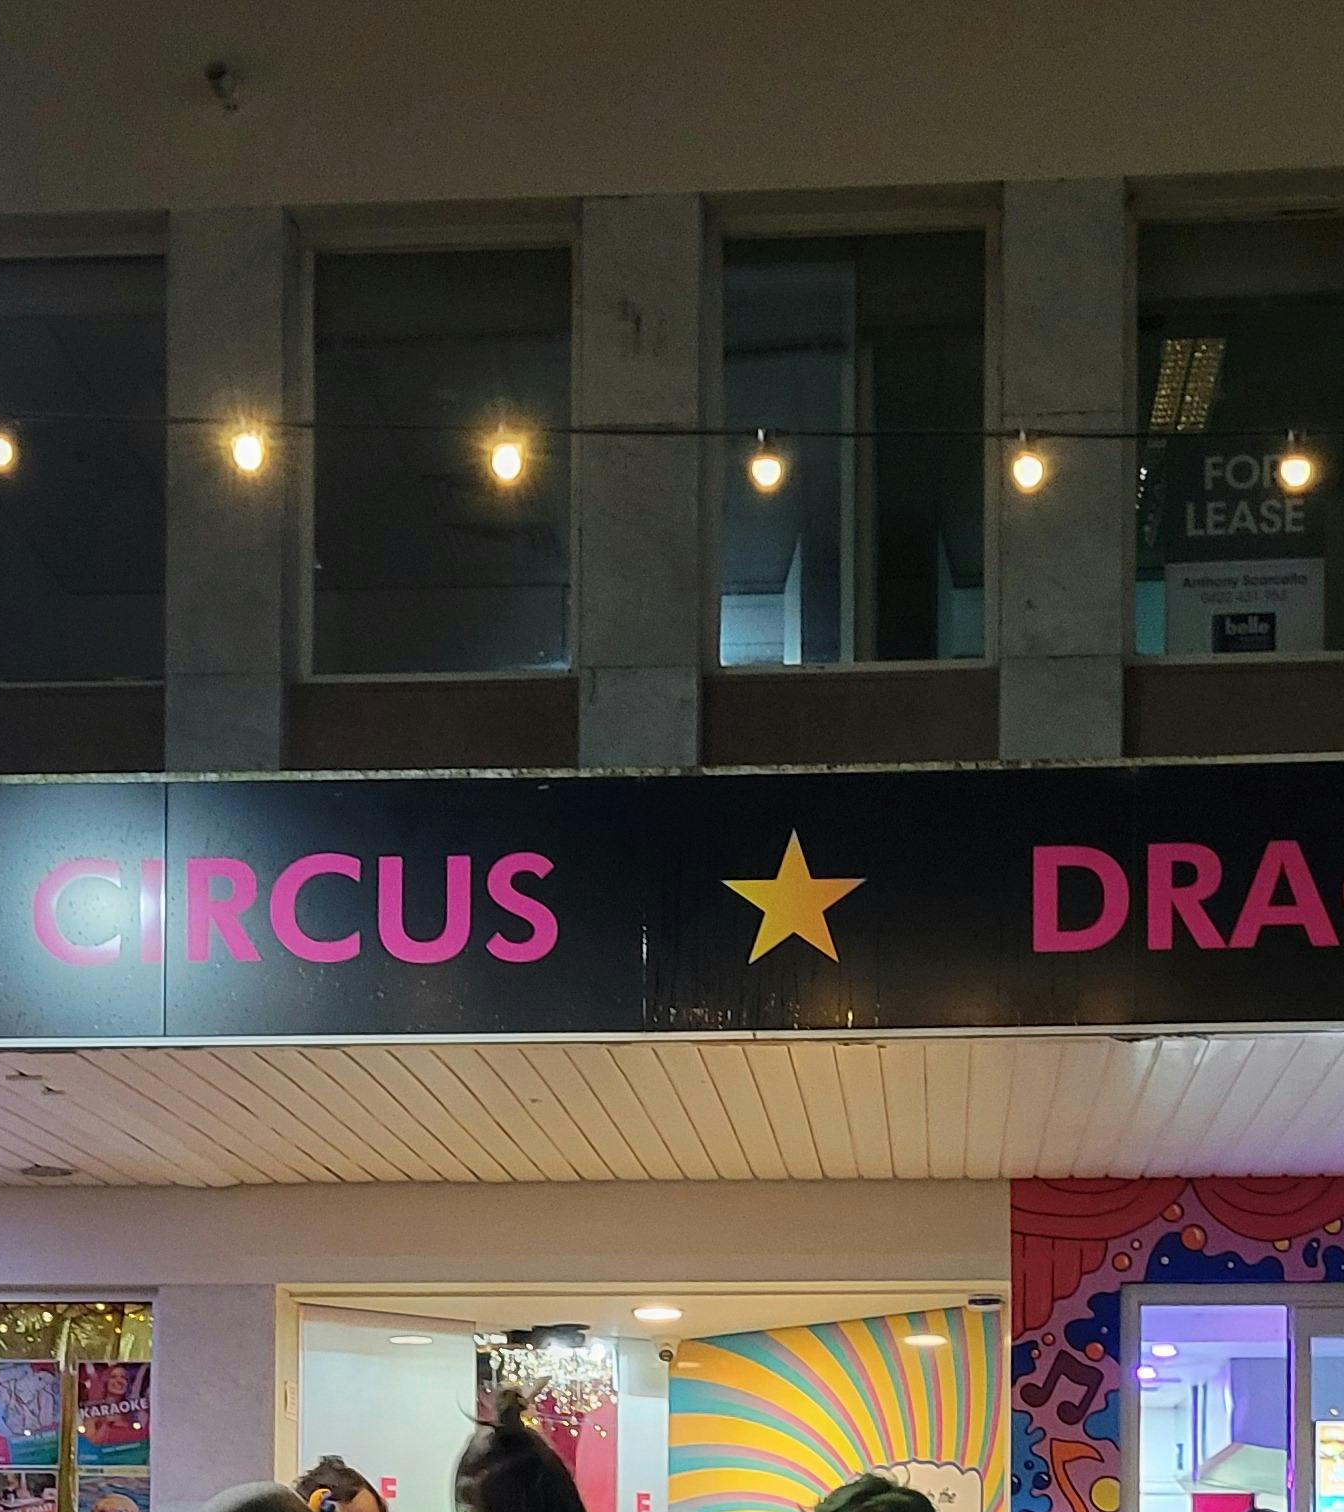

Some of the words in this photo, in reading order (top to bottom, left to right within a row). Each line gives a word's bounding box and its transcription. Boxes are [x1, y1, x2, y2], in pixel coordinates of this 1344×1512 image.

[1185, 498, 1306, 537] LEASE
[32, 851, 559, 966] CIRCUS
[80, 1398, 149, 1418] KARAOKE
